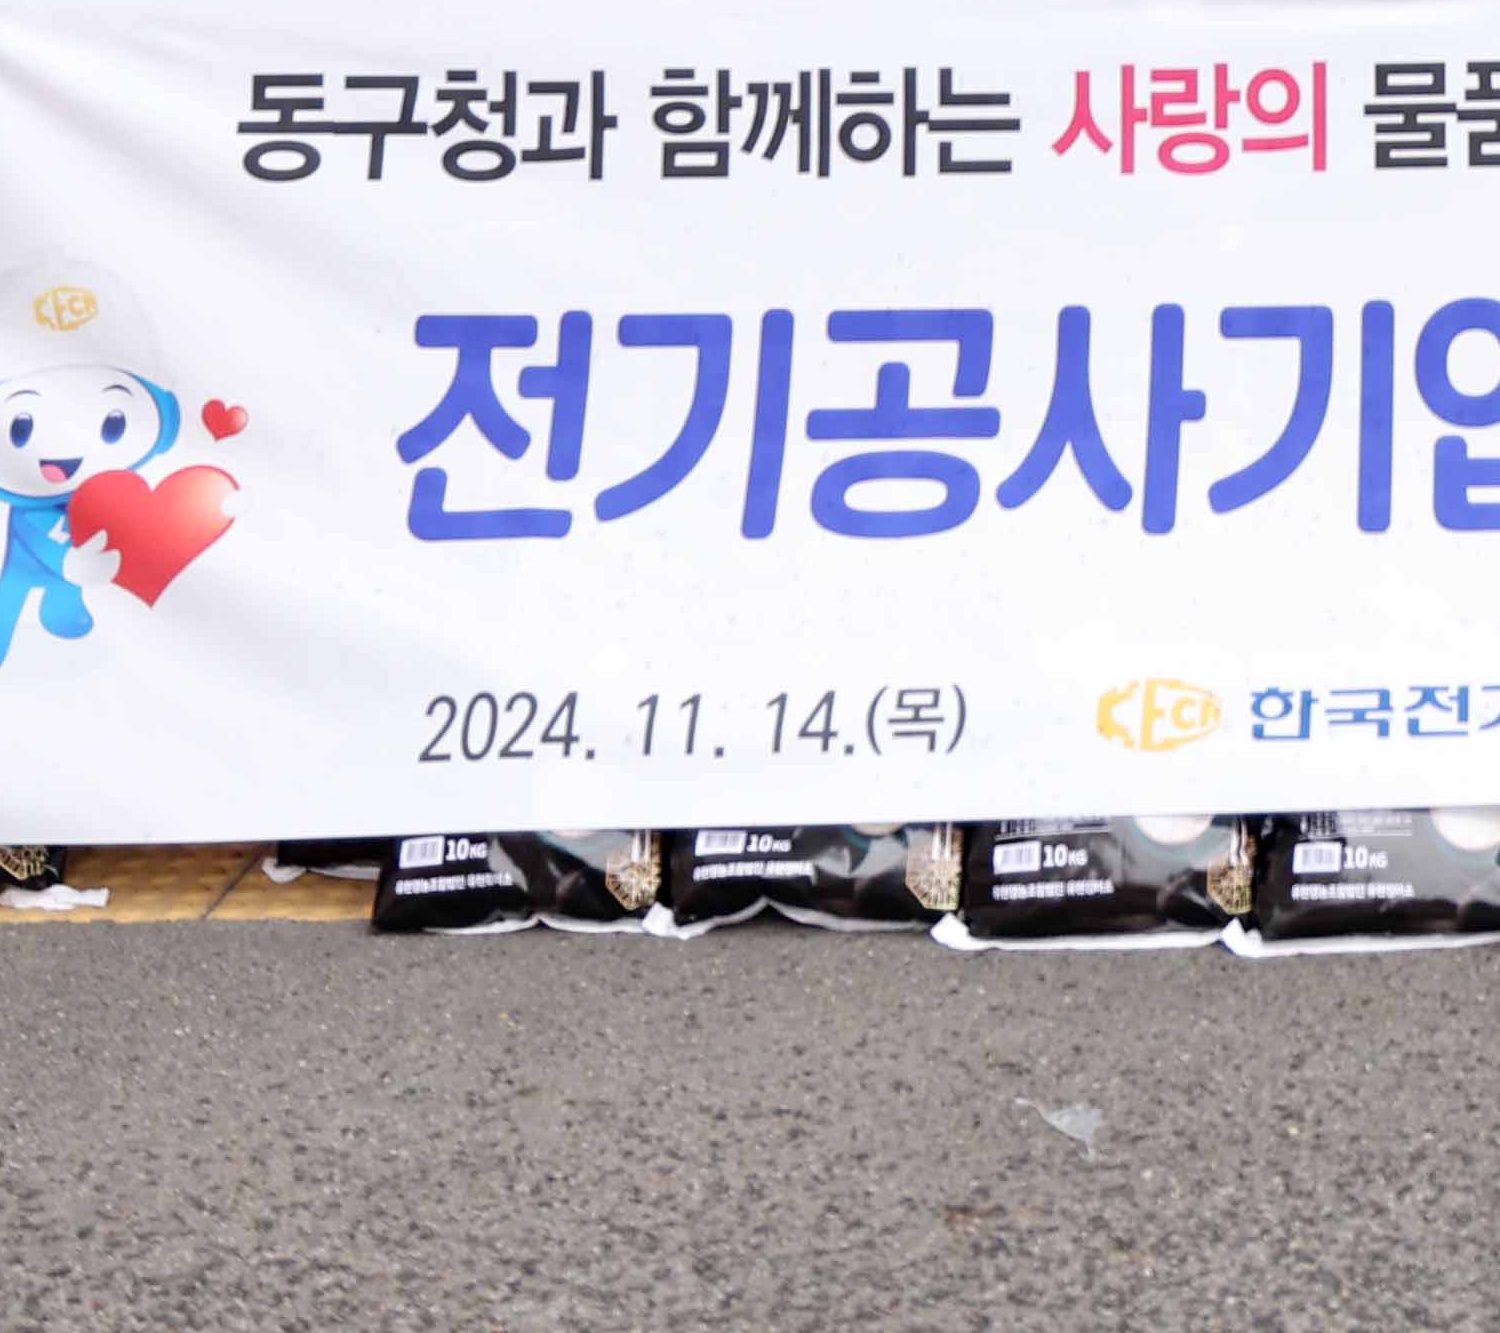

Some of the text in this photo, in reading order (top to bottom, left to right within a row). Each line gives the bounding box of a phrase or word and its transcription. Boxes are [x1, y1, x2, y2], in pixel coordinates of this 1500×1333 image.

[237, 70, 618, 182] 동구청과
[650, 67, 1020, 178] 함께하는
[1052, 61, 1326, 175] 사랑의
[418, 685, 966, 762] 2024. 11. 14.(목)
